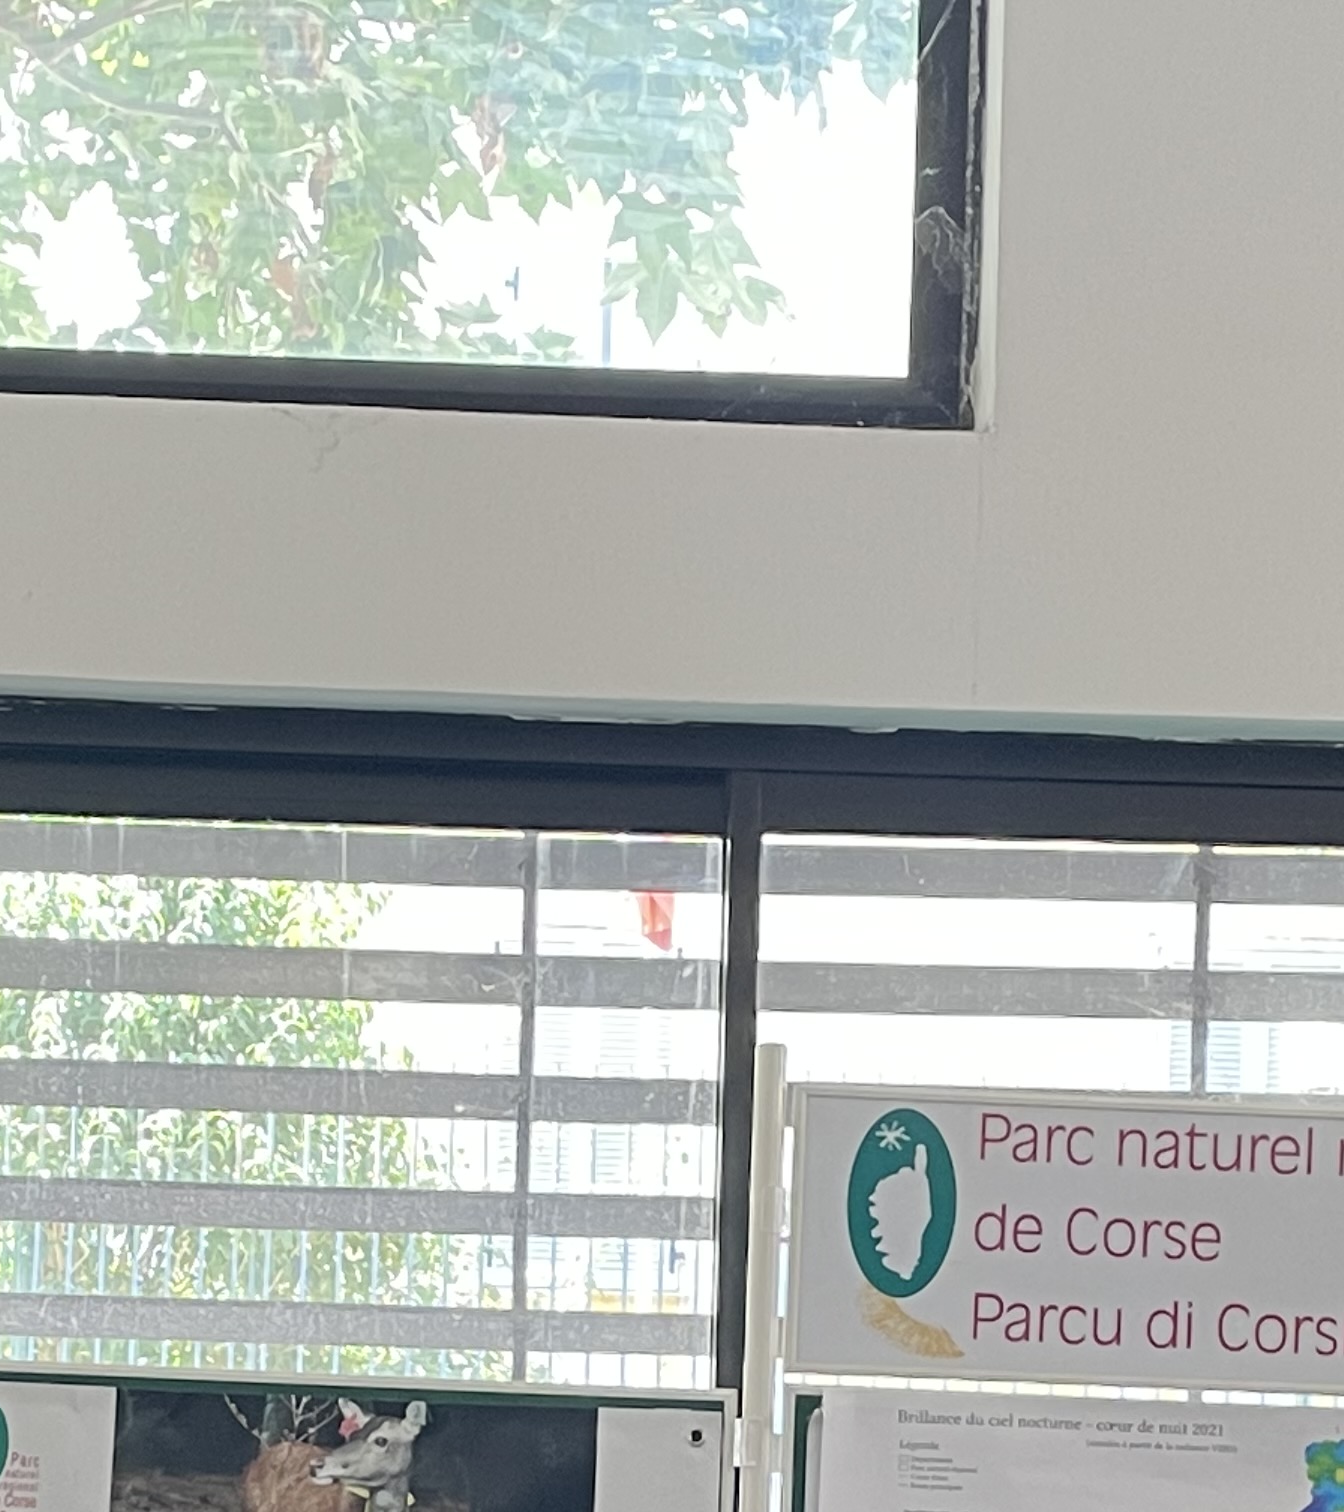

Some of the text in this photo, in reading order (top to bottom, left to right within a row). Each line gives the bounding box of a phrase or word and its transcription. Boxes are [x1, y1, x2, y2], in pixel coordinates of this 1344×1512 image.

[979, 1112, 1095, 1166] Parc
[1117, 1123, 1314, 1177] naturel
[974, 1204, 1222, 1262] de Corse
[971, 1292, 1122, 1347] Parcu
[1147, 1301, 1194, 1351] di
[897, 1409, 962, 1425] Brillance
[966, 1412, 985, 1426] du
[988, 1413, 1013, 1428] ciel
[1018, 1416, 1082, 1430] nocturne
[1137, 1419, 1154, 1434] de
[1159, 1422, 1188, 1435] nuit
[1192, 1422, 1223, 1437] 2021
[11, 1451, 40, 1467] Parc
